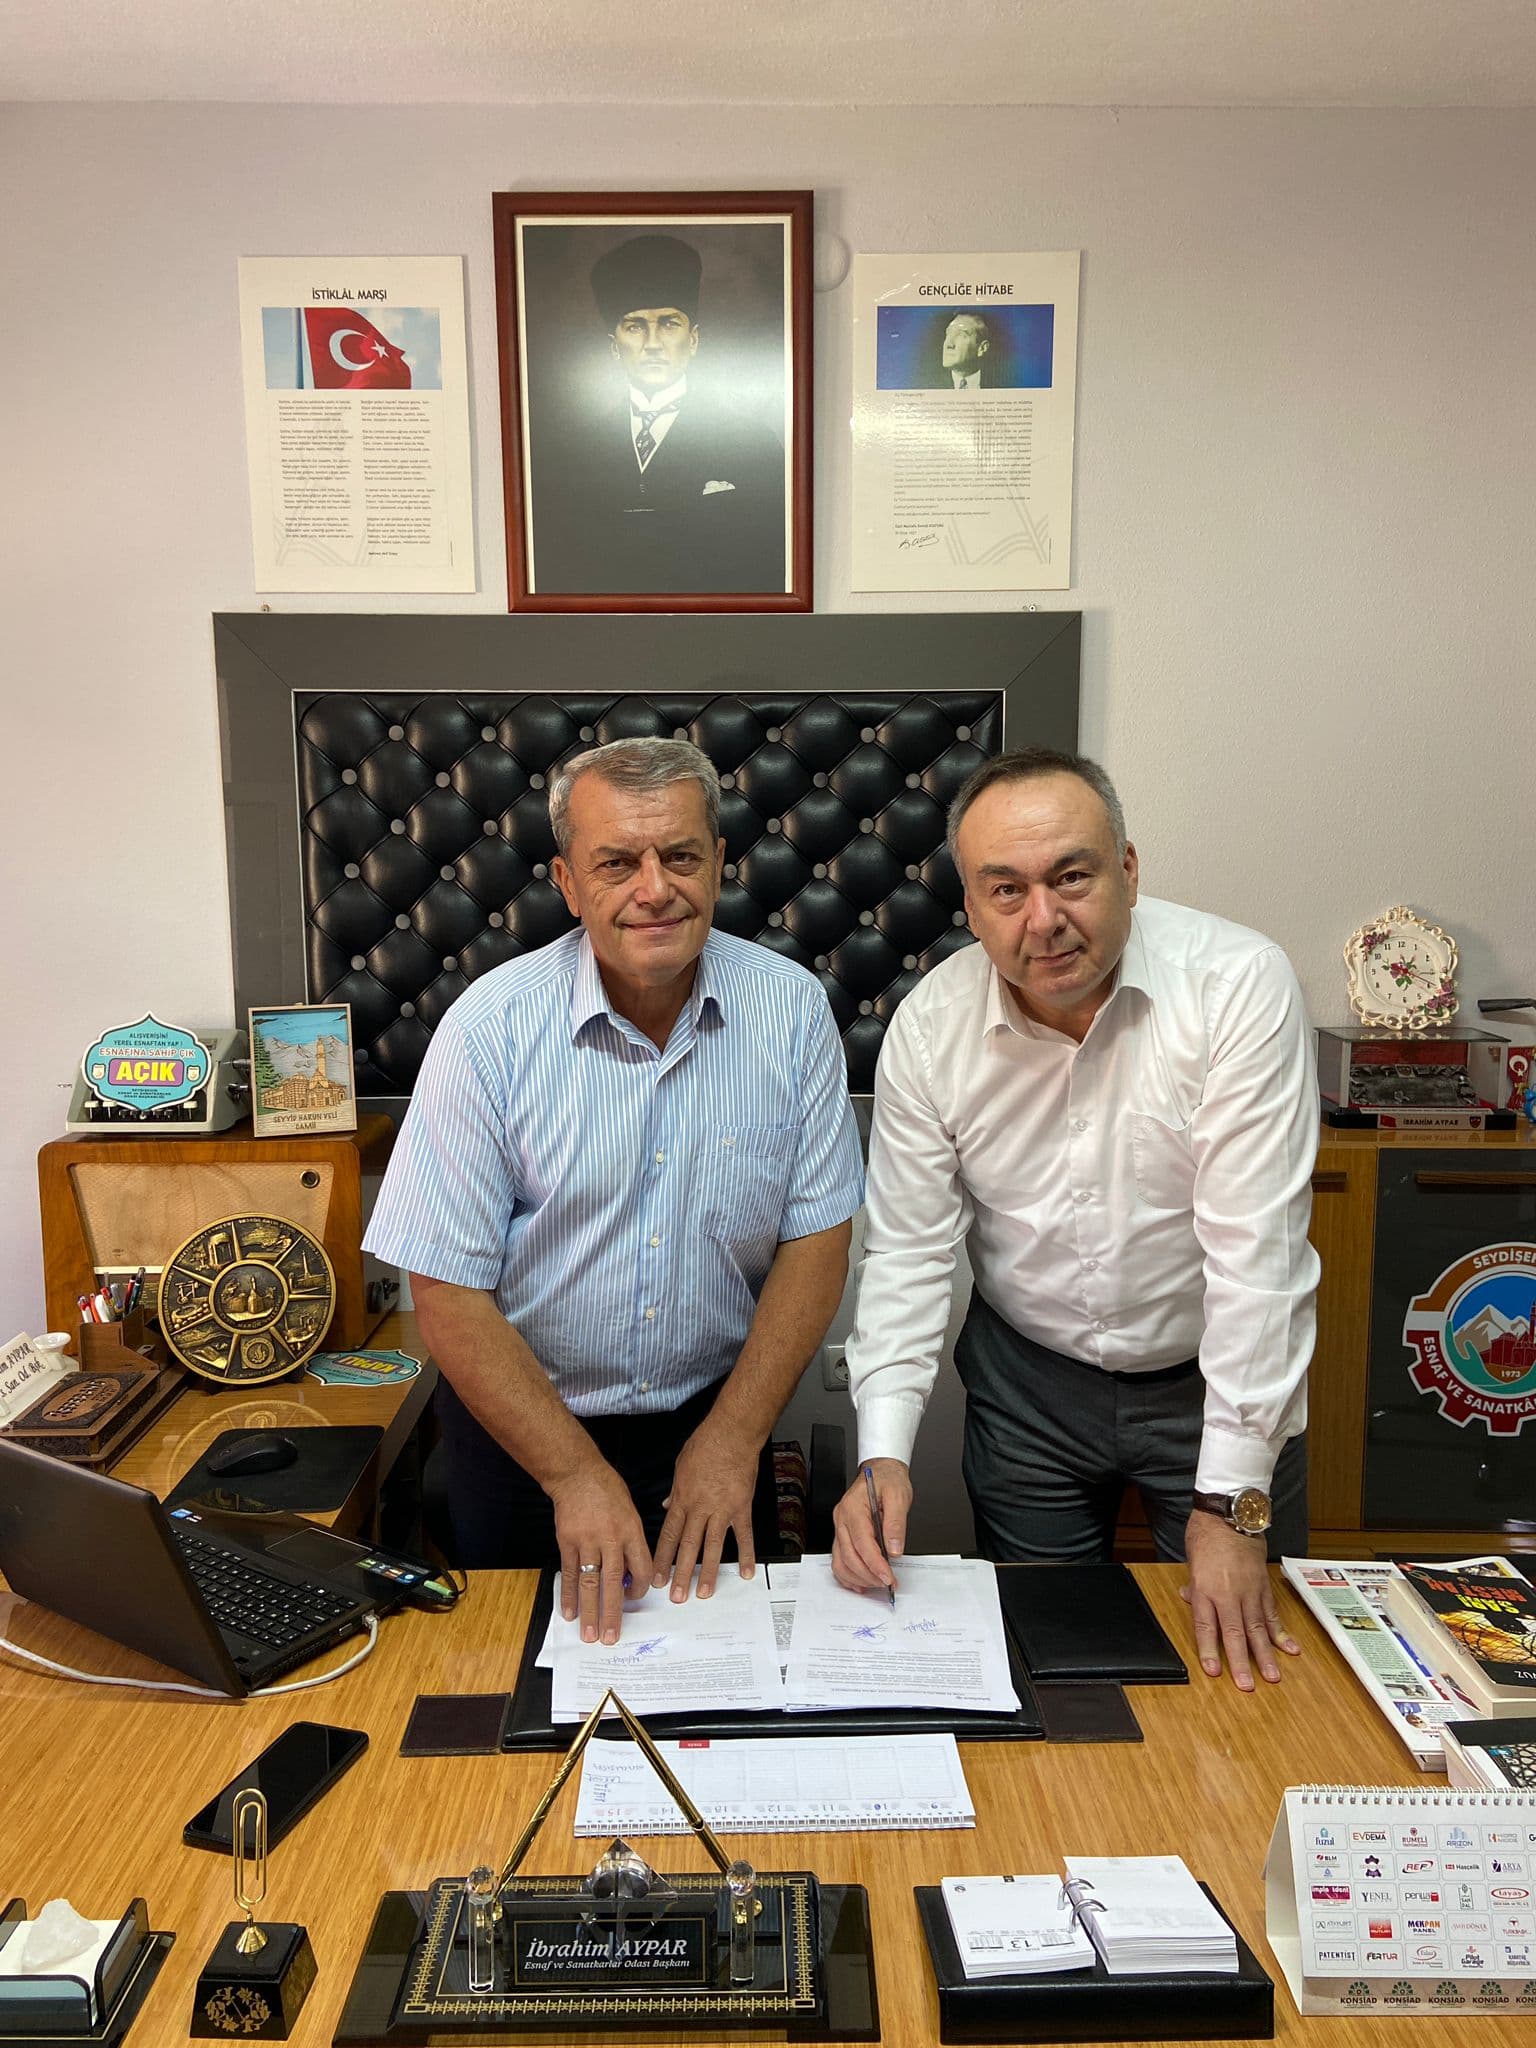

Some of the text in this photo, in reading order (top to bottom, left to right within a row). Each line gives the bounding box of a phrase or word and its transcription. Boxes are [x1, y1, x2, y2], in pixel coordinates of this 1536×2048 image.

[918, 282, 1014, 298] GENÇLİĞE HİTABE
[357, 288, 387, 302] MARŞI
[99, 1048, 146, 1056] ESNAFINA
[116, 1061, 177, 1084] AÇIK
[298, 1113, 322, 1121] HARUN
[1423, 1336, 1448, 1380] ESNAF
[1501, 1370, 1521, 1378] 1973
[1446, 1379, 1467, 1398] VE
[607, 1808, 621, 1817] 15
[1406, 1861, 1428, 1871] REF
[1407, 1920, 1441, 1929] MEKPAN
[526, 1937, 688, 1957] İbrahim AYPAR
[1010, 1940, 1032, 1948] 13
[1366, 1952, 1398, 1961] FERTUR
[524, 1959, 690, 1971] Esnaf ve Sanatkarlar Odası Başkanı
[1340, 1996, 1378, 2005] KONSİAD
[1383, 1996, 1421, 2005] KONSİAD
[1428, 1996, 1466, 2005] KONSİAD
[1472, 1995, 1510, 2004] KONSİAD
